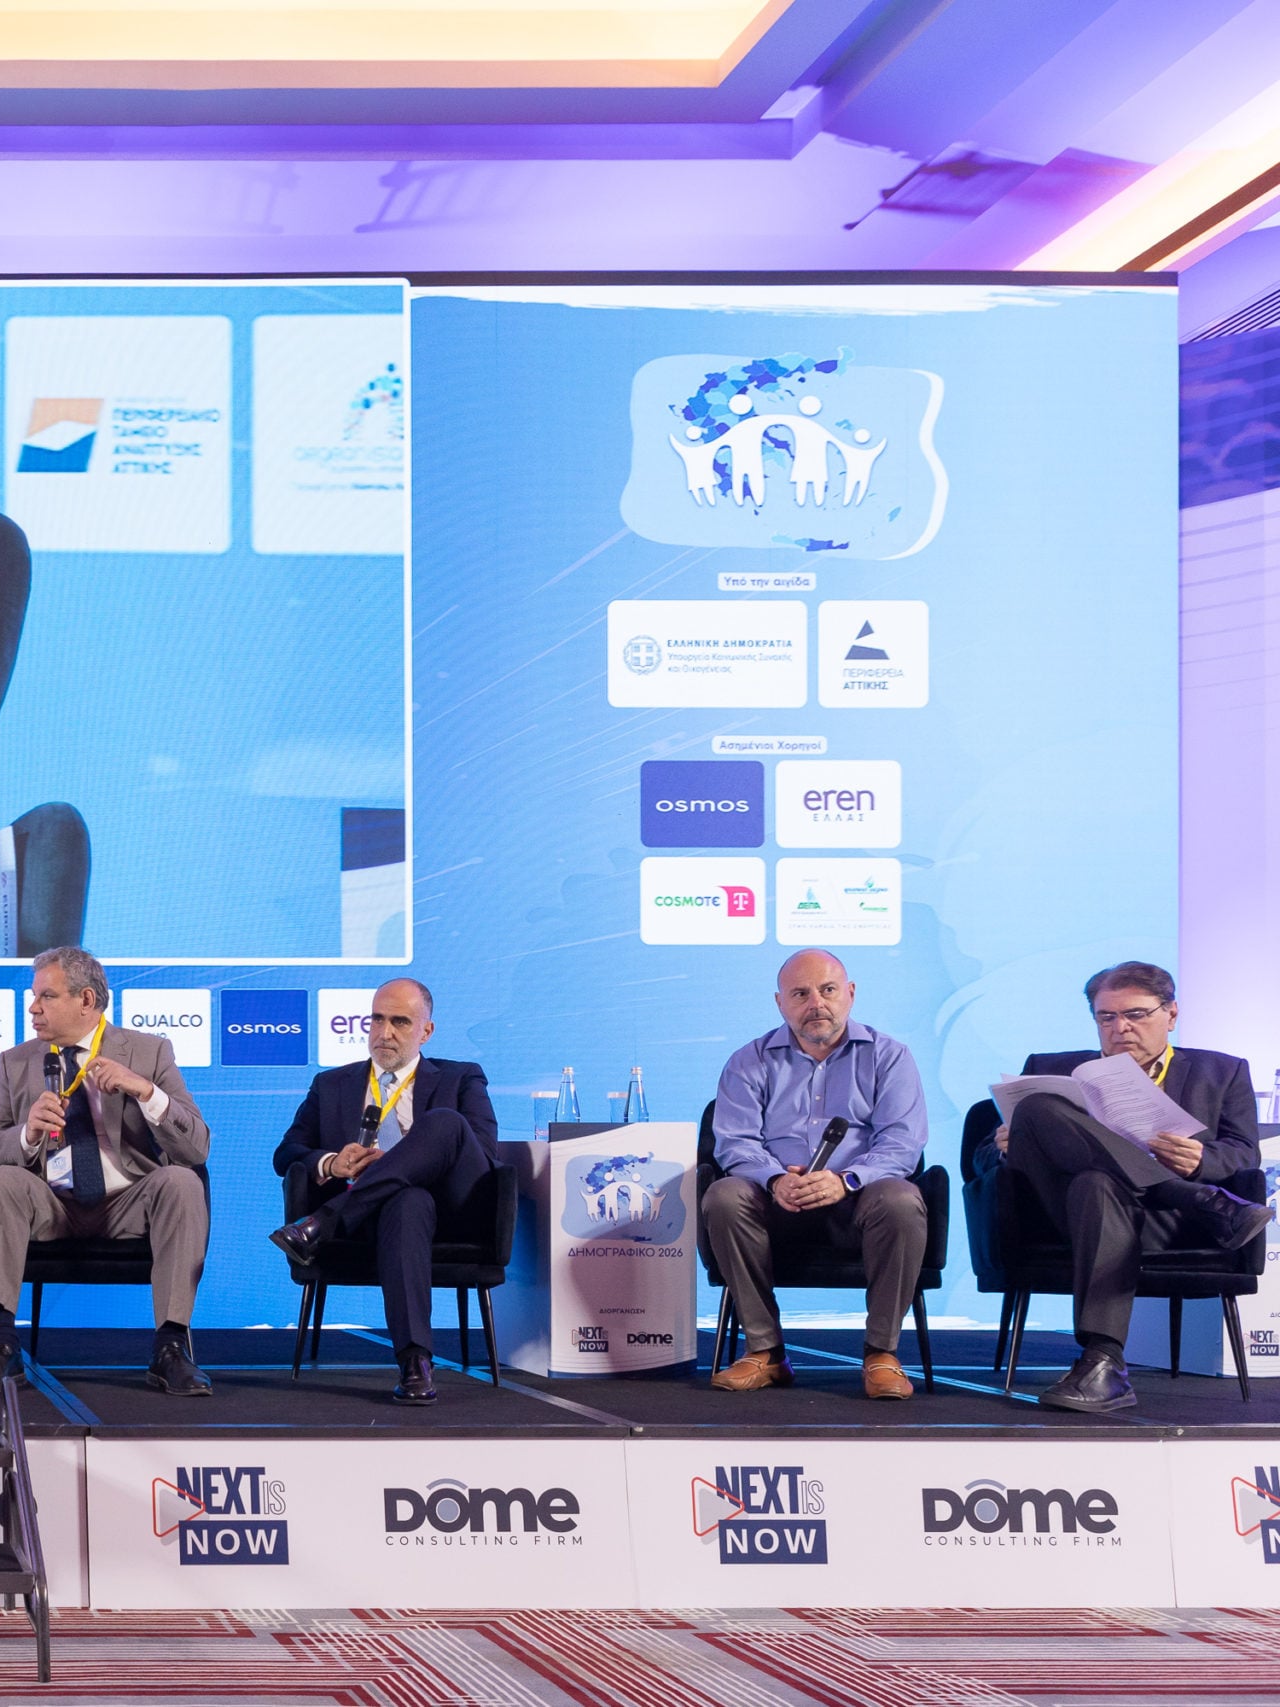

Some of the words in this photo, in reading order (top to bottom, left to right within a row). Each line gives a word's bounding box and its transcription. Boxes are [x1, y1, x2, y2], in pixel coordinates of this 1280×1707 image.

[723, 576, 747, 587] Υπό
[751, 578, 770, 589] την
[773, 576, 811, 588] αιγίδα
[667, 639, 720, 648] ΕΛΛΗΝΙΚΗ
[723, 639, 793, 648] ΔΗΜΟΚΡΑΤΙΑ
[842, 681, 889, 691] ΑΤΤΙΚΗΣ
[655, 799, 750, 813] osmos
[803, 789, 875, 811] eren
[812, 813, 865, 822] ΕΛΛΑΣ
[654, 895, 721, 907] COSMOTE
[131, 1014, 203, 1028] QUALCO
[331, 1015, 372, 1034] ere
[227, 1023, 302, 1035] osmos
[339, 1036, 366, 1044] ΕΛΛ
[568, 1247, 655, 1257] ΔΗΜΟΓΡΑΦΙΚΟ
[658, 1247, 683, 1257] 2026
[579, 1327, 603, 1339] NEXT
[1250, 1330, 1274, 1343] NEXT
[580, 1342, 606, 1350] NOW
[1251, 1346, 1277, 1354] NOW
[176, 1467, 266, 1515] NEXT
[262, 1480, 287, 1515] IS
[715, 1466, 804, 1514] NEXT
[800, 1480, 825, 1515] IS
[186, 1528, 278, 1555] NOW
[385, 1536, 519, 1546] CONSULTING
[533, 1536, 583, 1546] FIRM
[726, 1528, 817, 1554] NOW
[924, 1536, 1058, 1546] CONSULTING
[1073, 1536, 1122, 1546] FIRM
